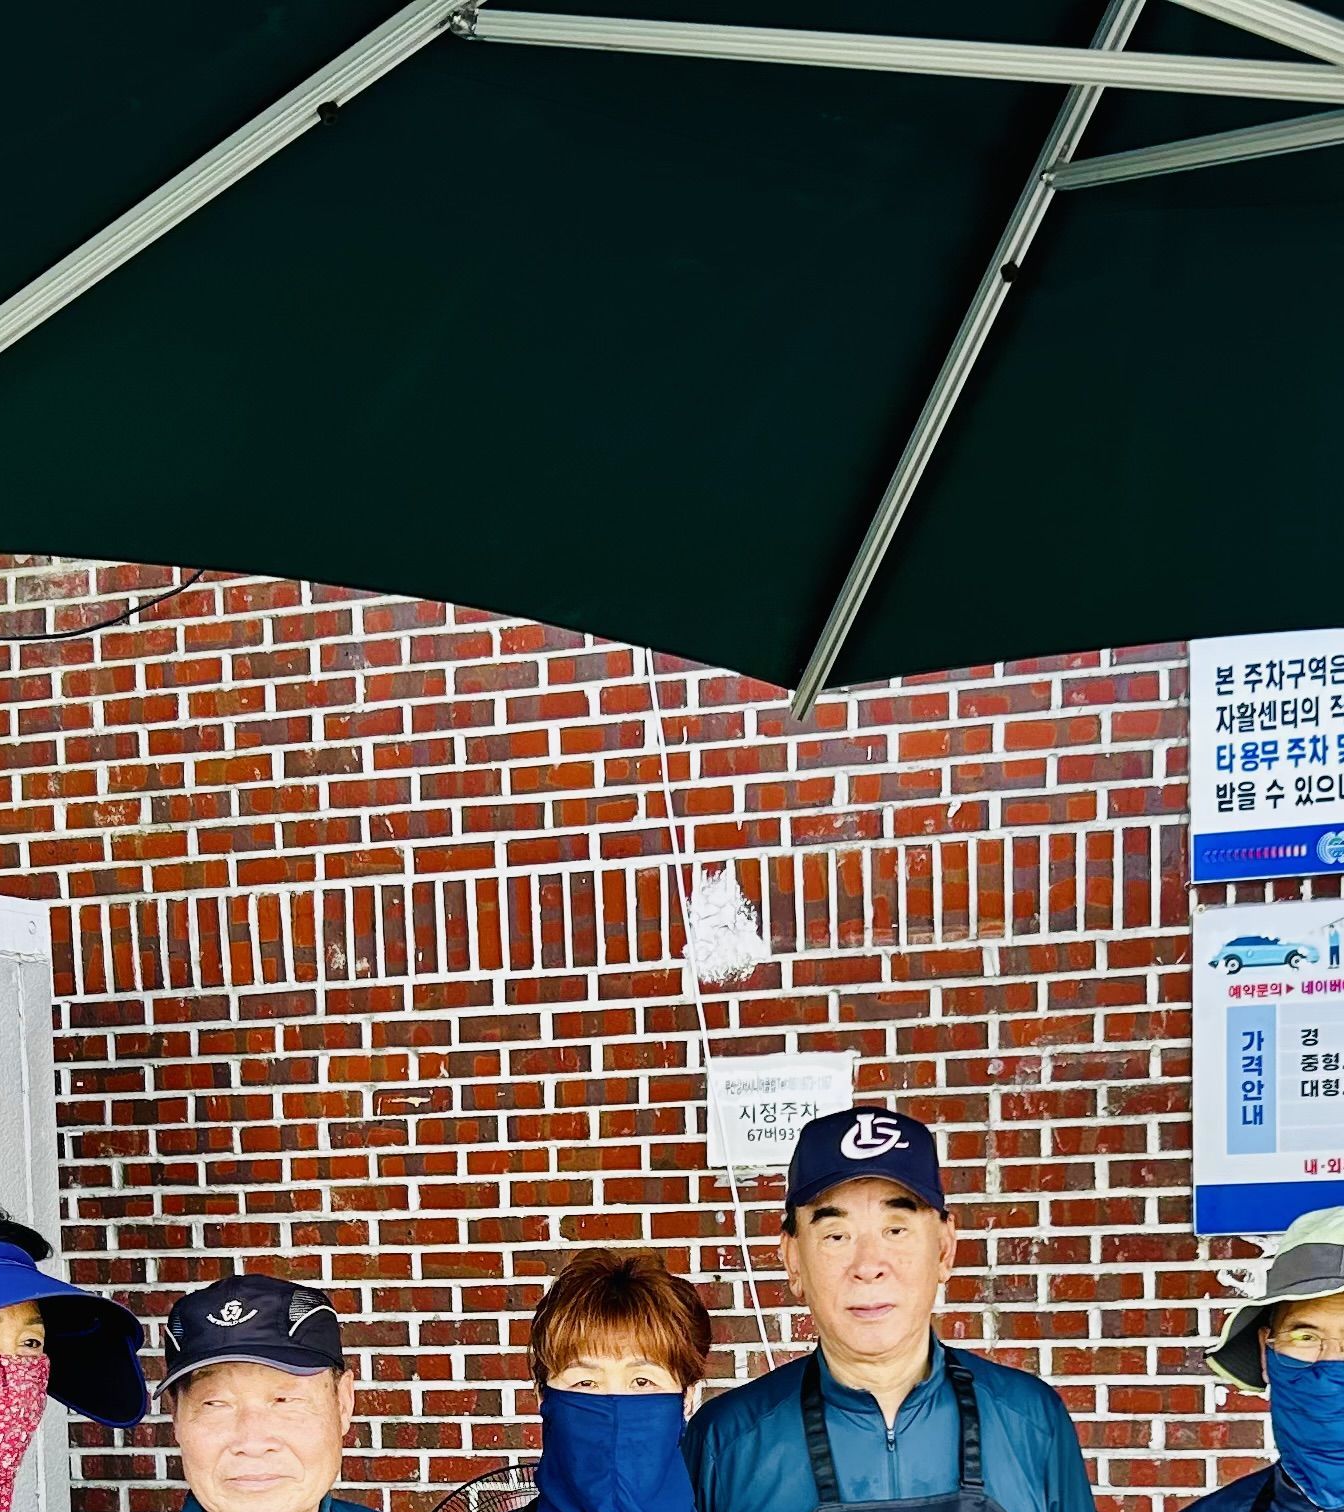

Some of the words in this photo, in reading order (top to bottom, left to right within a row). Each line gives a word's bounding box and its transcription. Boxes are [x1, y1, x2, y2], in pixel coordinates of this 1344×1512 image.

[1215, 665, 1235, 696] 본
[1215, 696, 1320, 735] 자활센터의
[1286, 733, 1329, 768] 주차
[1216, 781, 1256, 813] 받을
[1265, 778, 1285, 810] 수
[1228, 982, 1283, 999] 예약문의
[1300, 1027, 1319, 1047] 경
[739, 1099, 820, 1124] 지정주차
[747, 1127, 802, 1143] 67버93
